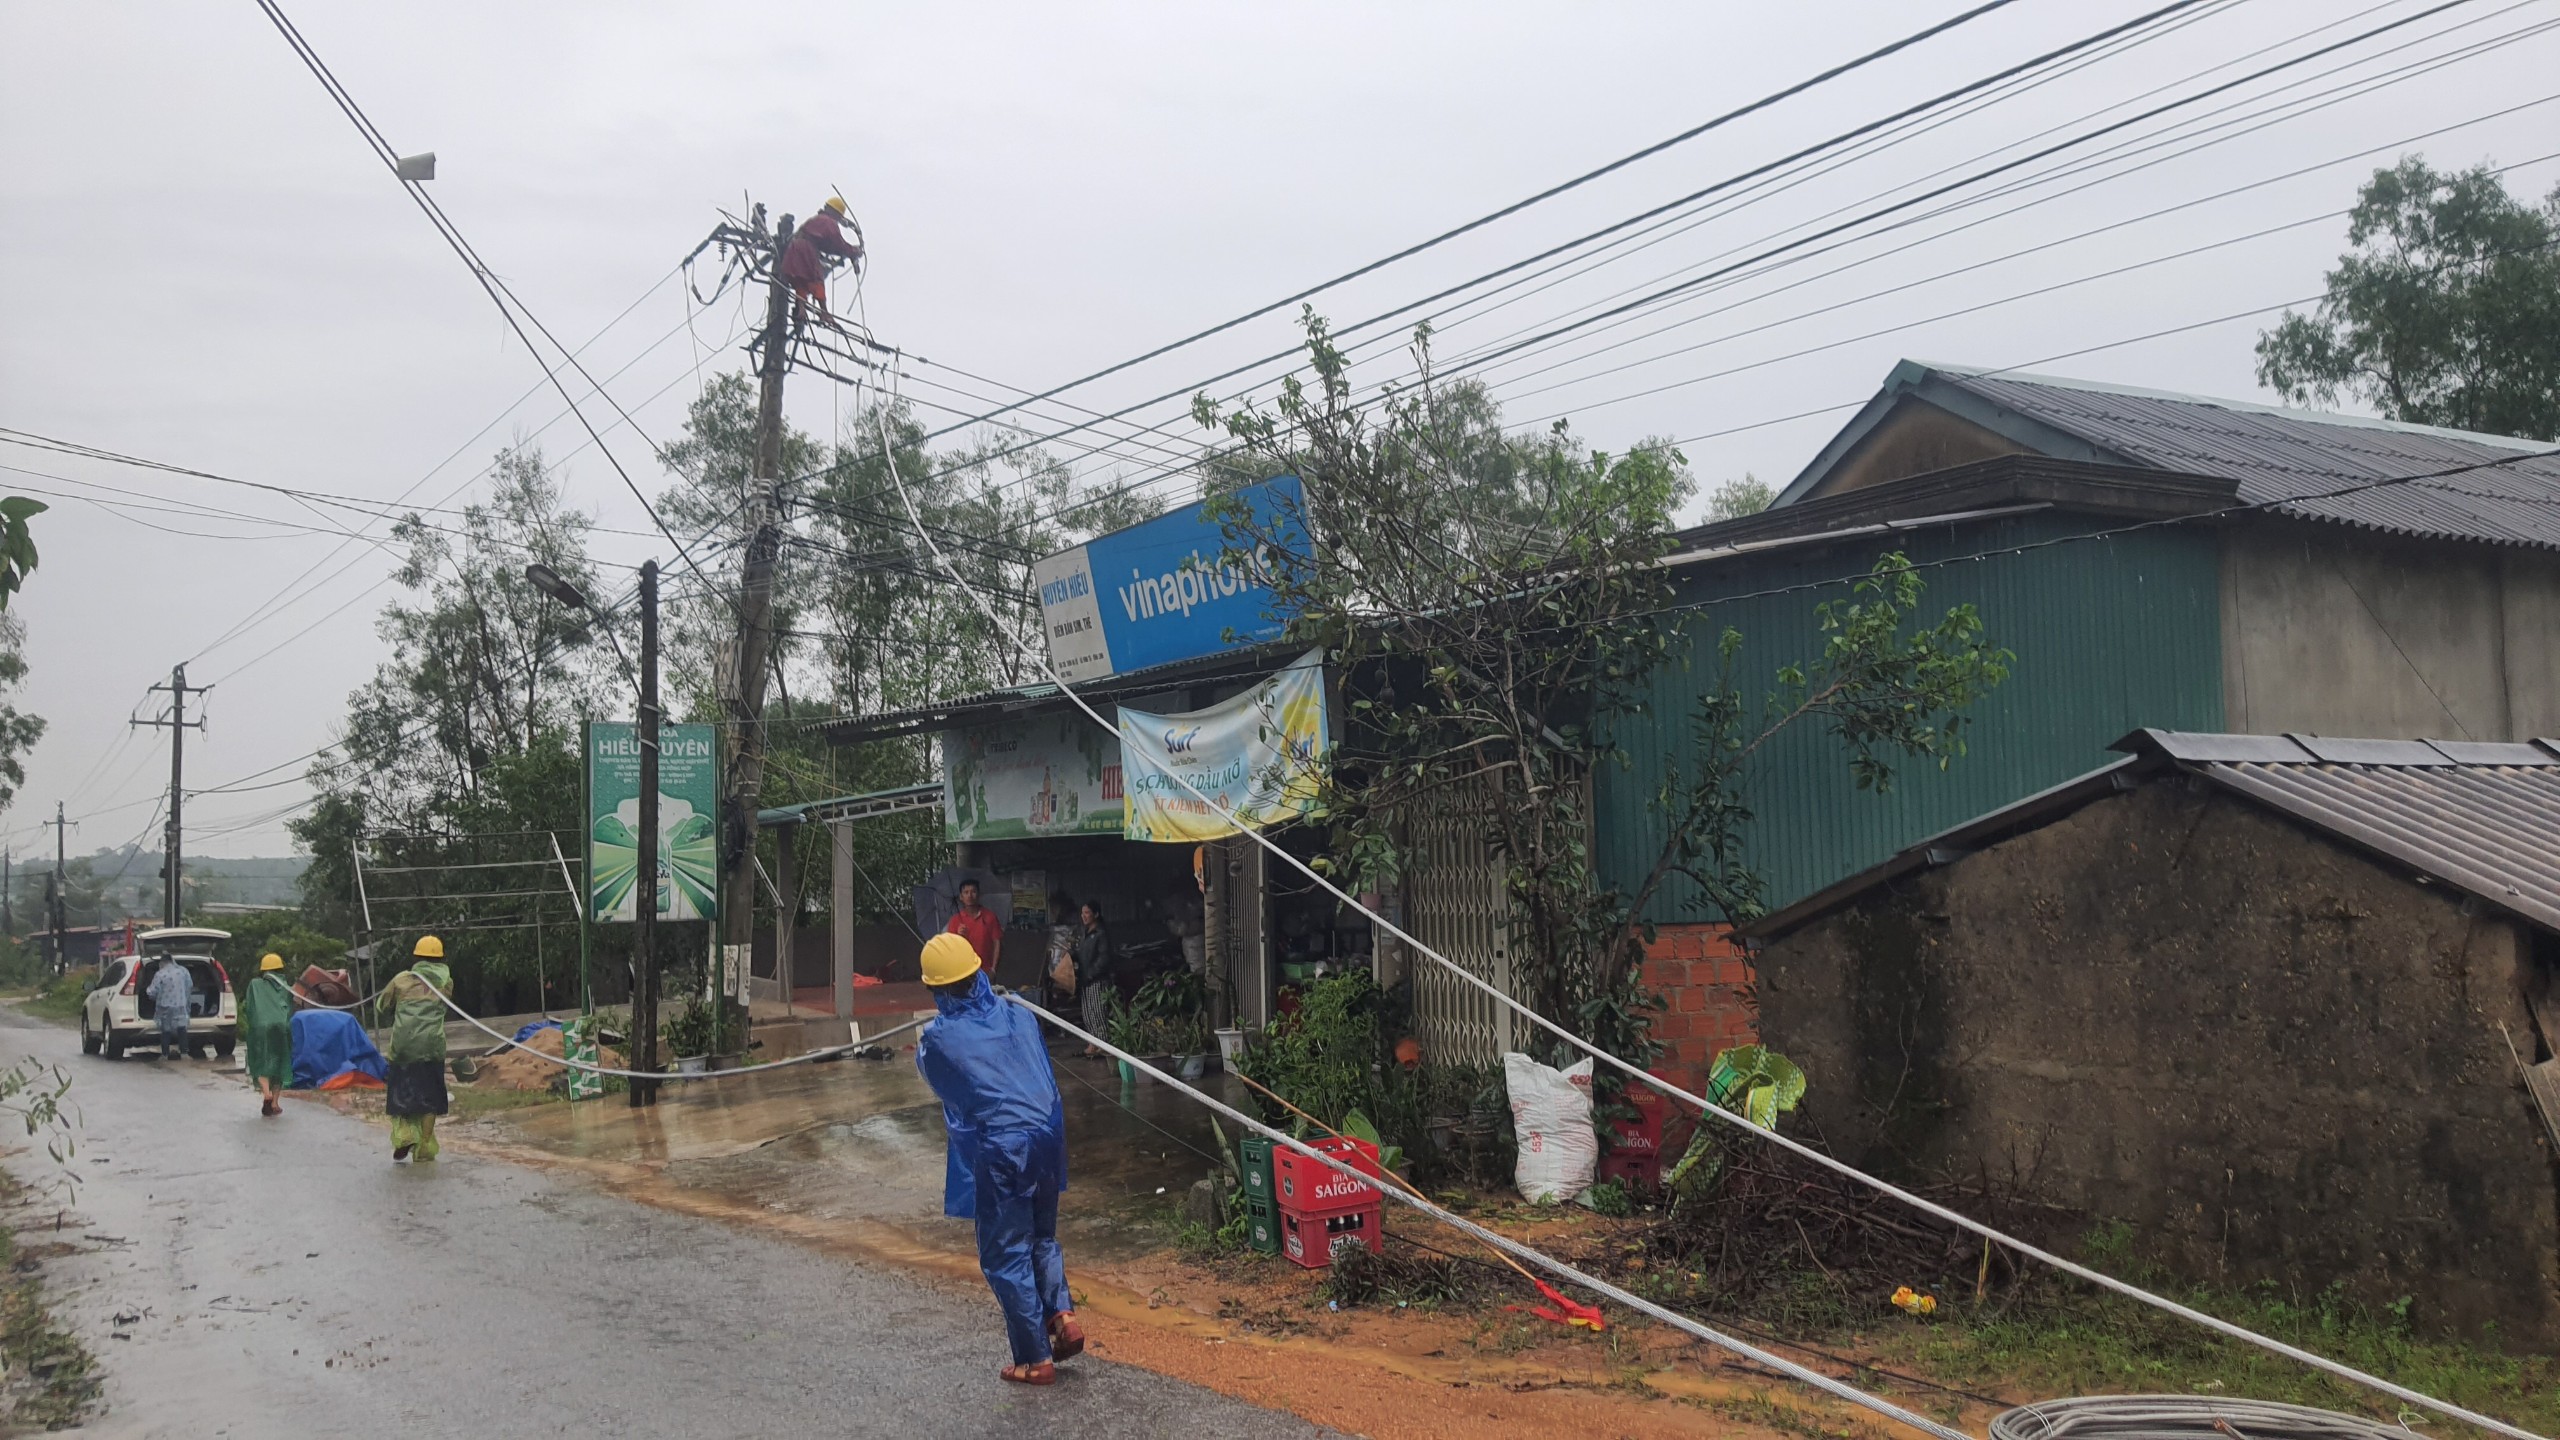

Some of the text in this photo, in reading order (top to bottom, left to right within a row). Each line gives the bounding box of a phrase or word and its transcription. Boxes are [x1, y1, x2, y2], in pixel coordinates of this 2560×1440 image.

[1119, 544, 1277, 622] vinaphone
[658, 738, 709, 756] UYÊN
[1164, 726, 1201, 754] Surf
[1196, 765, 1219, 790] DẦU
[1615, 1137, 1652, 1148] IGON
[1332, 1173, 1349, 1183] BIA
[1315, 1181, 1367, 1198] SAIGON
